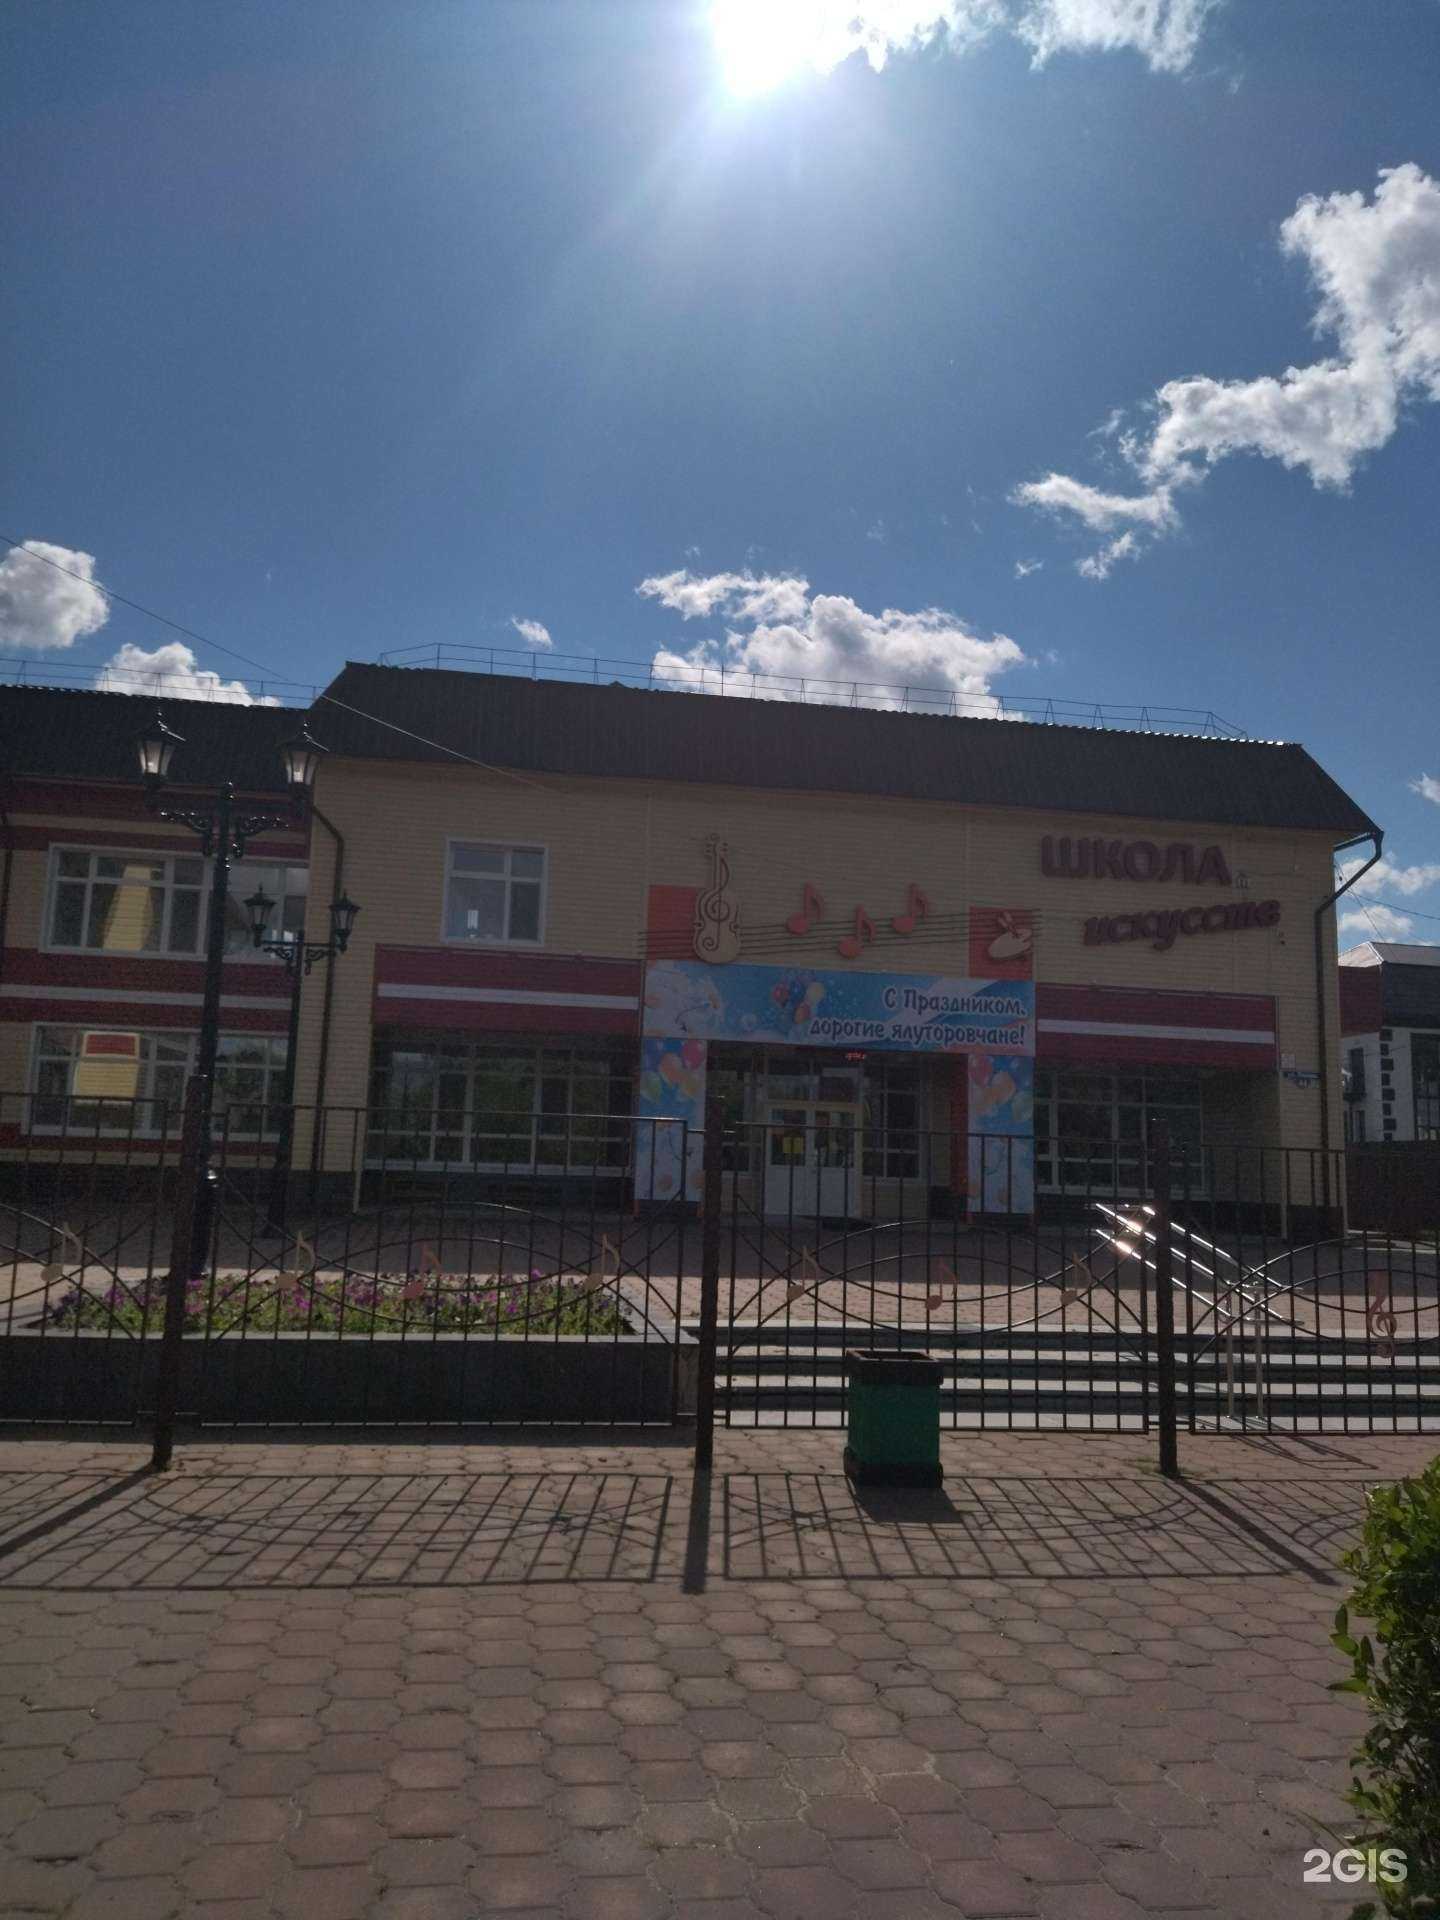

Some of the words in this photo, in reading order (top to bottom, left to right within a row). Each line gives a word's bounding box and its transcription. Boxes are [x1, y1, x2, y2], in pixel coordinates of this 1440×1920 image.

[1041, 834, 1232, 885] ШКОЛА
[883, 987, 898, 1009] С
[809, 1017, 885, 1041] дорогие
[891, 1022, 1025, 1047] ялуторовчане!
